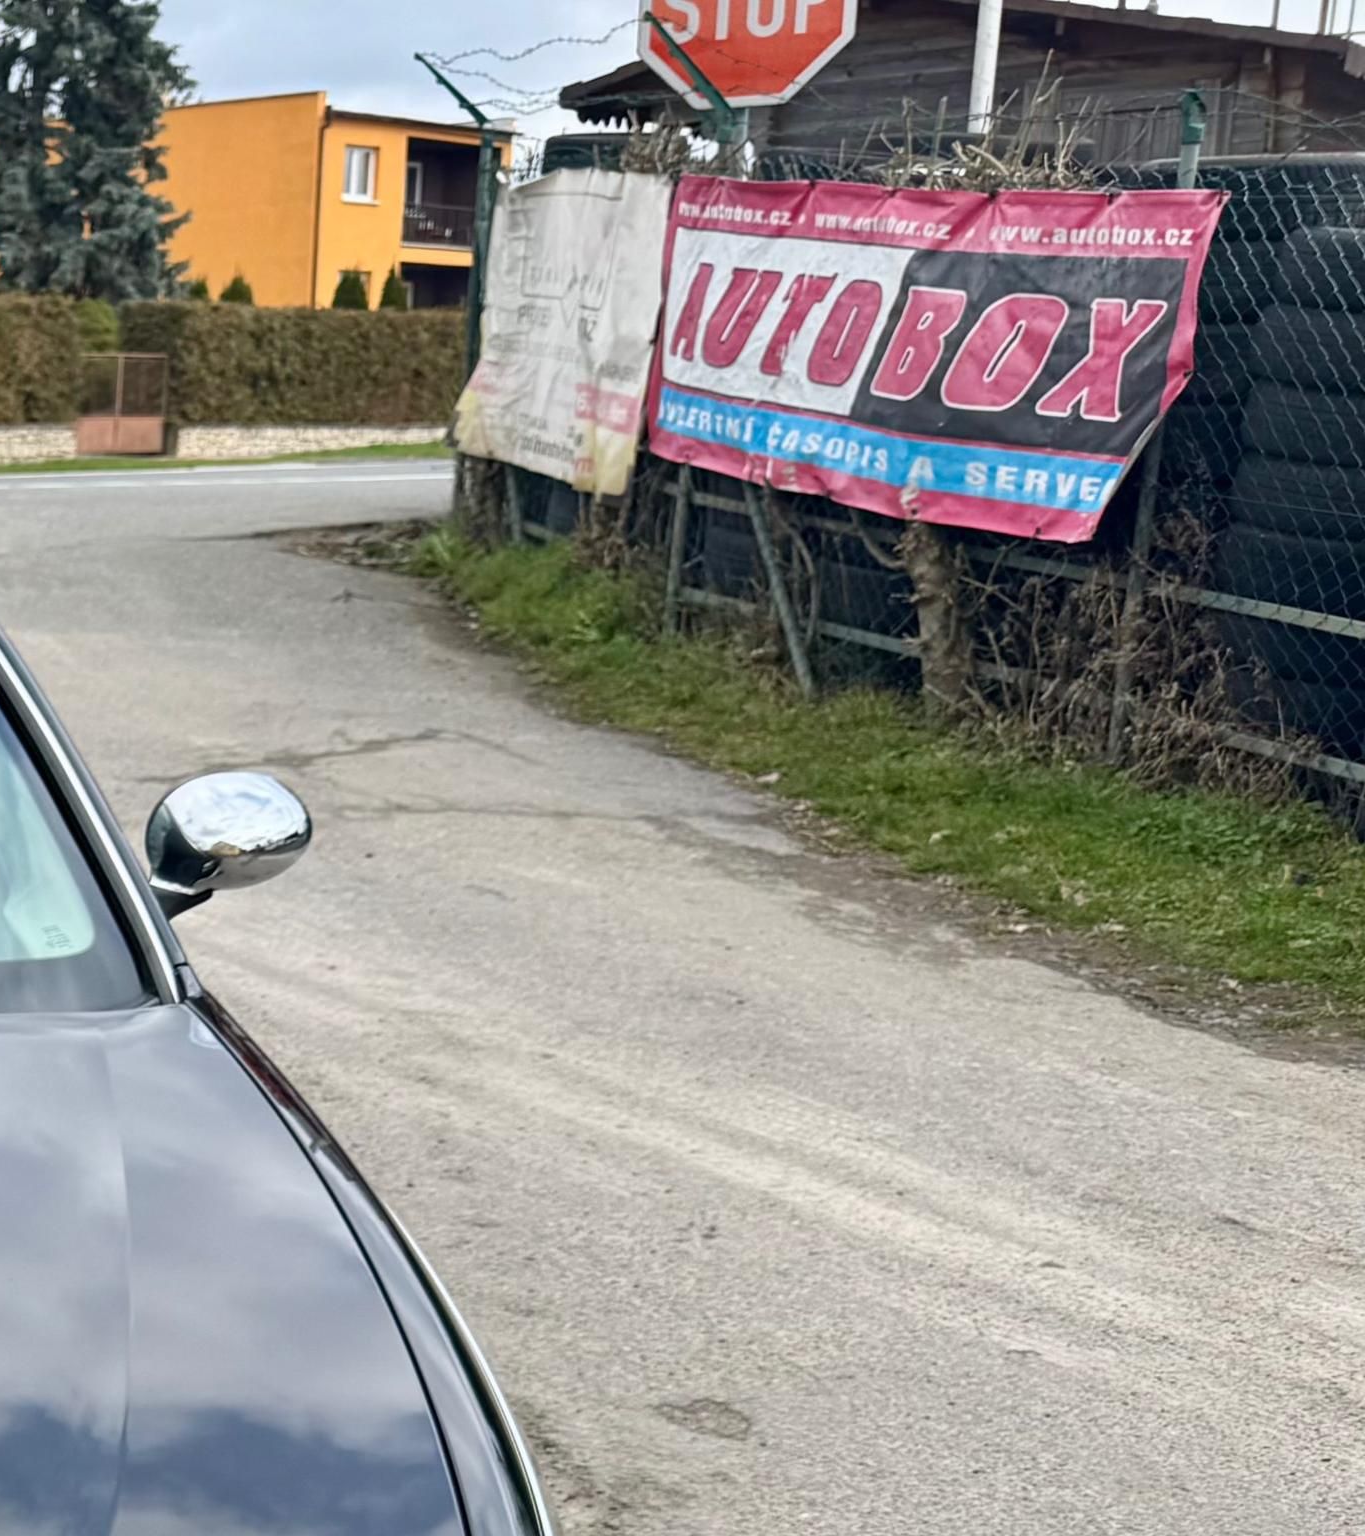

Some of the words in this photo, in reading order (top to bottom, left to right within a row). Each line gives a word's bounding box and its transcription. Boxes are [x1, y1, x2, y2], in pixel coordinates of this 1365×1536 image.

[669, 262, 1168, 423] AUTOBOX
[766, 421, 888, 472] ČASOPIS
[908, 456, 935, 481] A
